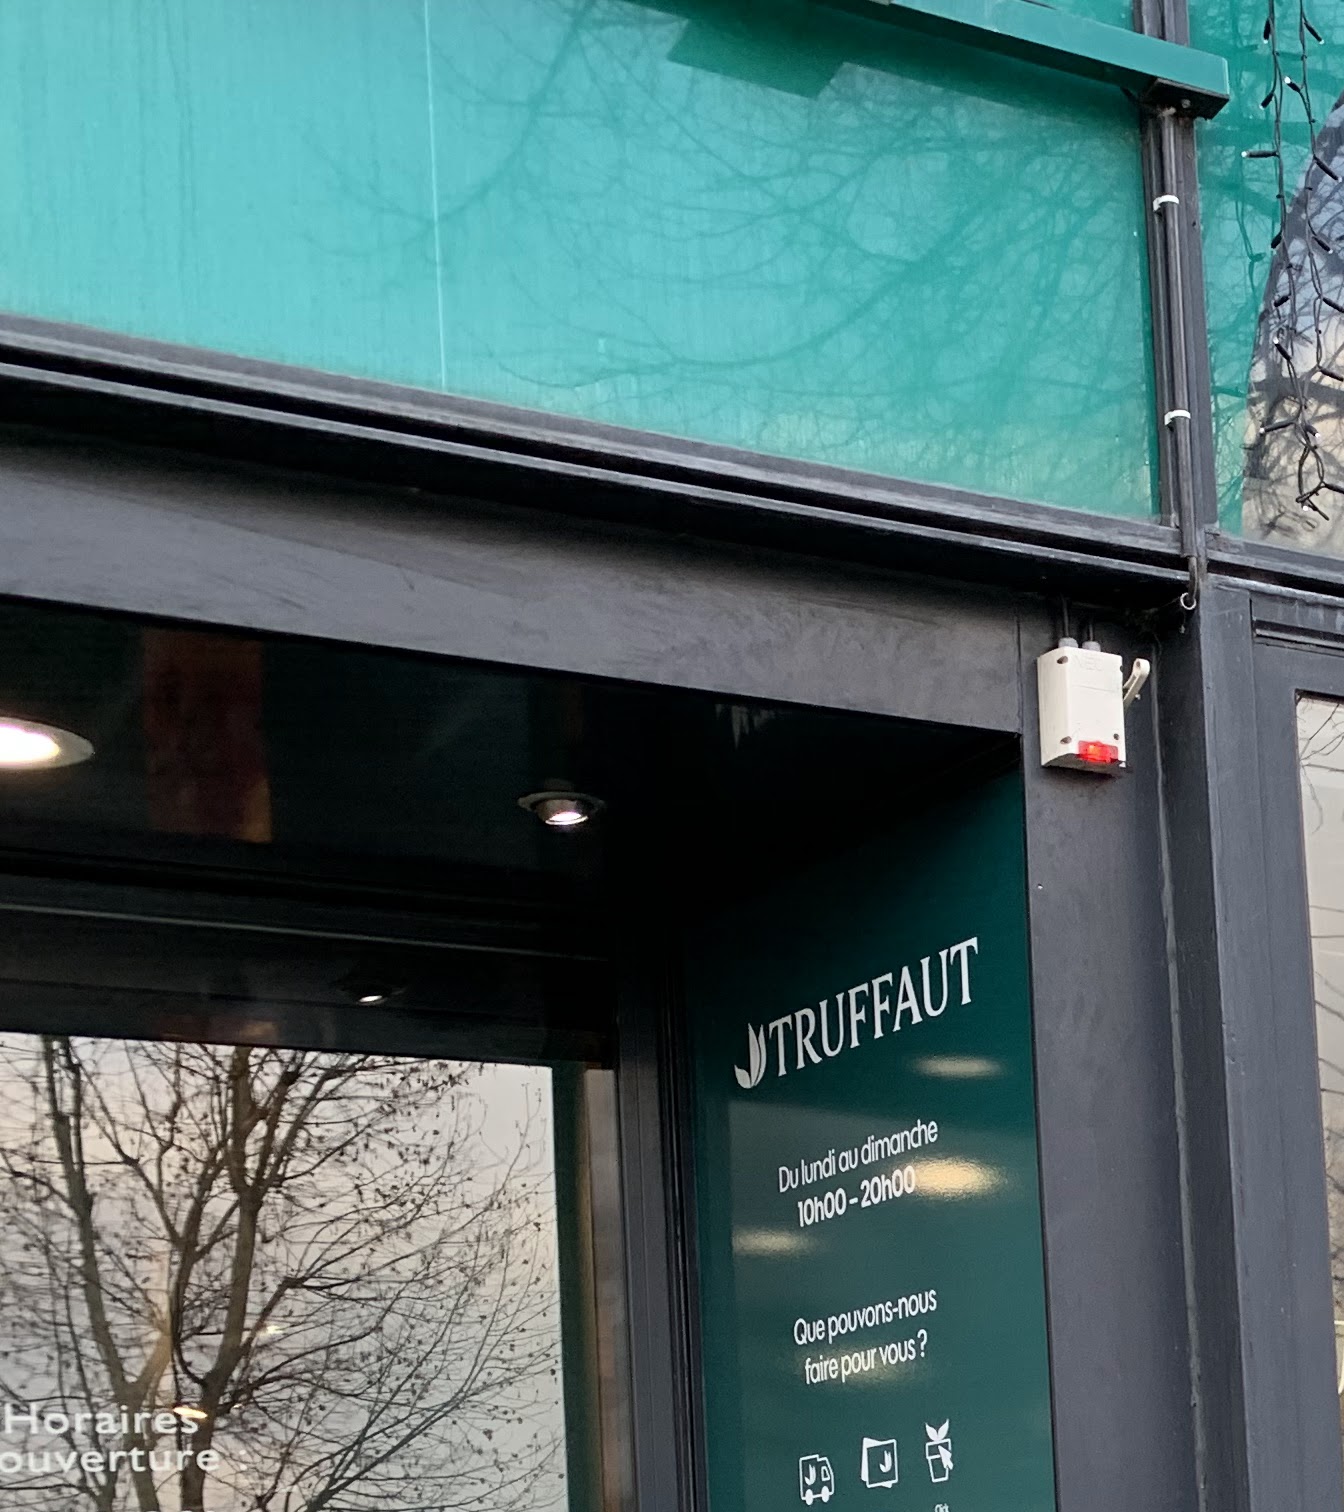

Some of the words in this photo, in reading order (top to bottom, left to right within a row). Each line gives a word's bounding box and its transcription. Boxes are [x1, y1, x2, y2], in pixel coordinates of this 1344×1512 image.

[768, 937, 979, 1079] TRUFFAUT
[778, 1164, 799, 1193] Du
[801, 1149, 836, 1186] lundi
[838, 1149, 859, 1172] au
[861, 1120, 938, 1166] dimanche
[797, 1184, 847, 1227] 10h00
[861, 1165, 916, 1208] 20h00
[794, 1317, 826, 1347] Que
[827, 1289, 938, 1345] pouvons-nous
[804, 1353, 839, 1385] faire
[841, 1350, 877, 1382] pour
[878, 1338, 915, 1368] vous
[4, 1402, 200, 1435] Horaires
